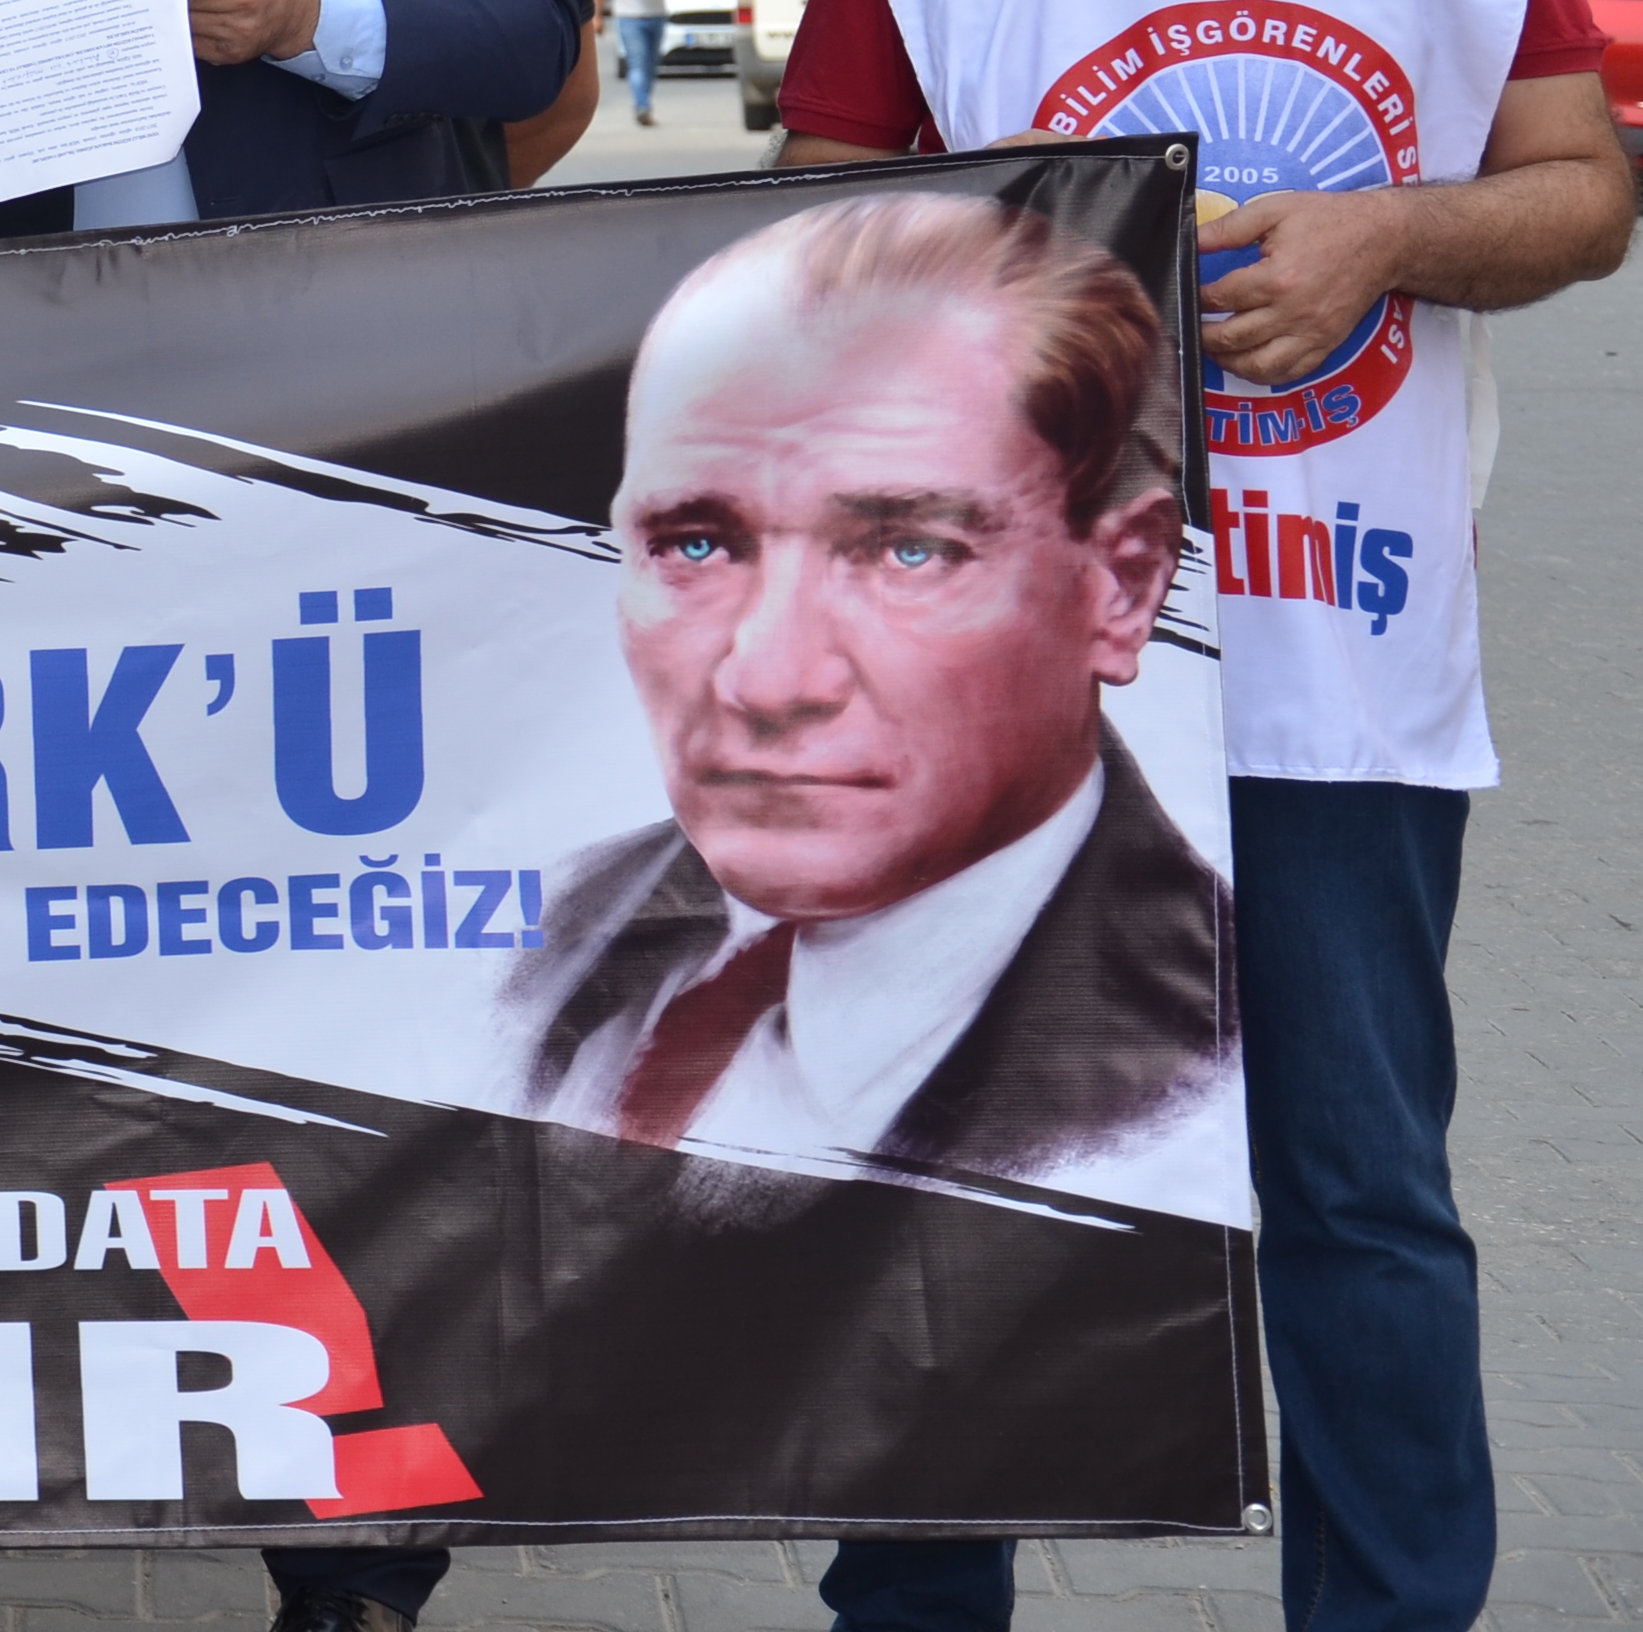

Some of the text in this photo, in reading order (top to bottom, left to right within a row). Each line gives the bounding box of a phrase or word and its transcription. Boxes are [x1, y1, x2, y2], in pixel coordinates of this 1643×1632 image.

[1050, 11, 1415, 138] BİLİM İŞGÖRENLERİ
[1204, 166, 1280, 184] 2005
[1209, 487, 1414, 635] timiş
[24, 852, 545, 963] EDECEĞİZ!
